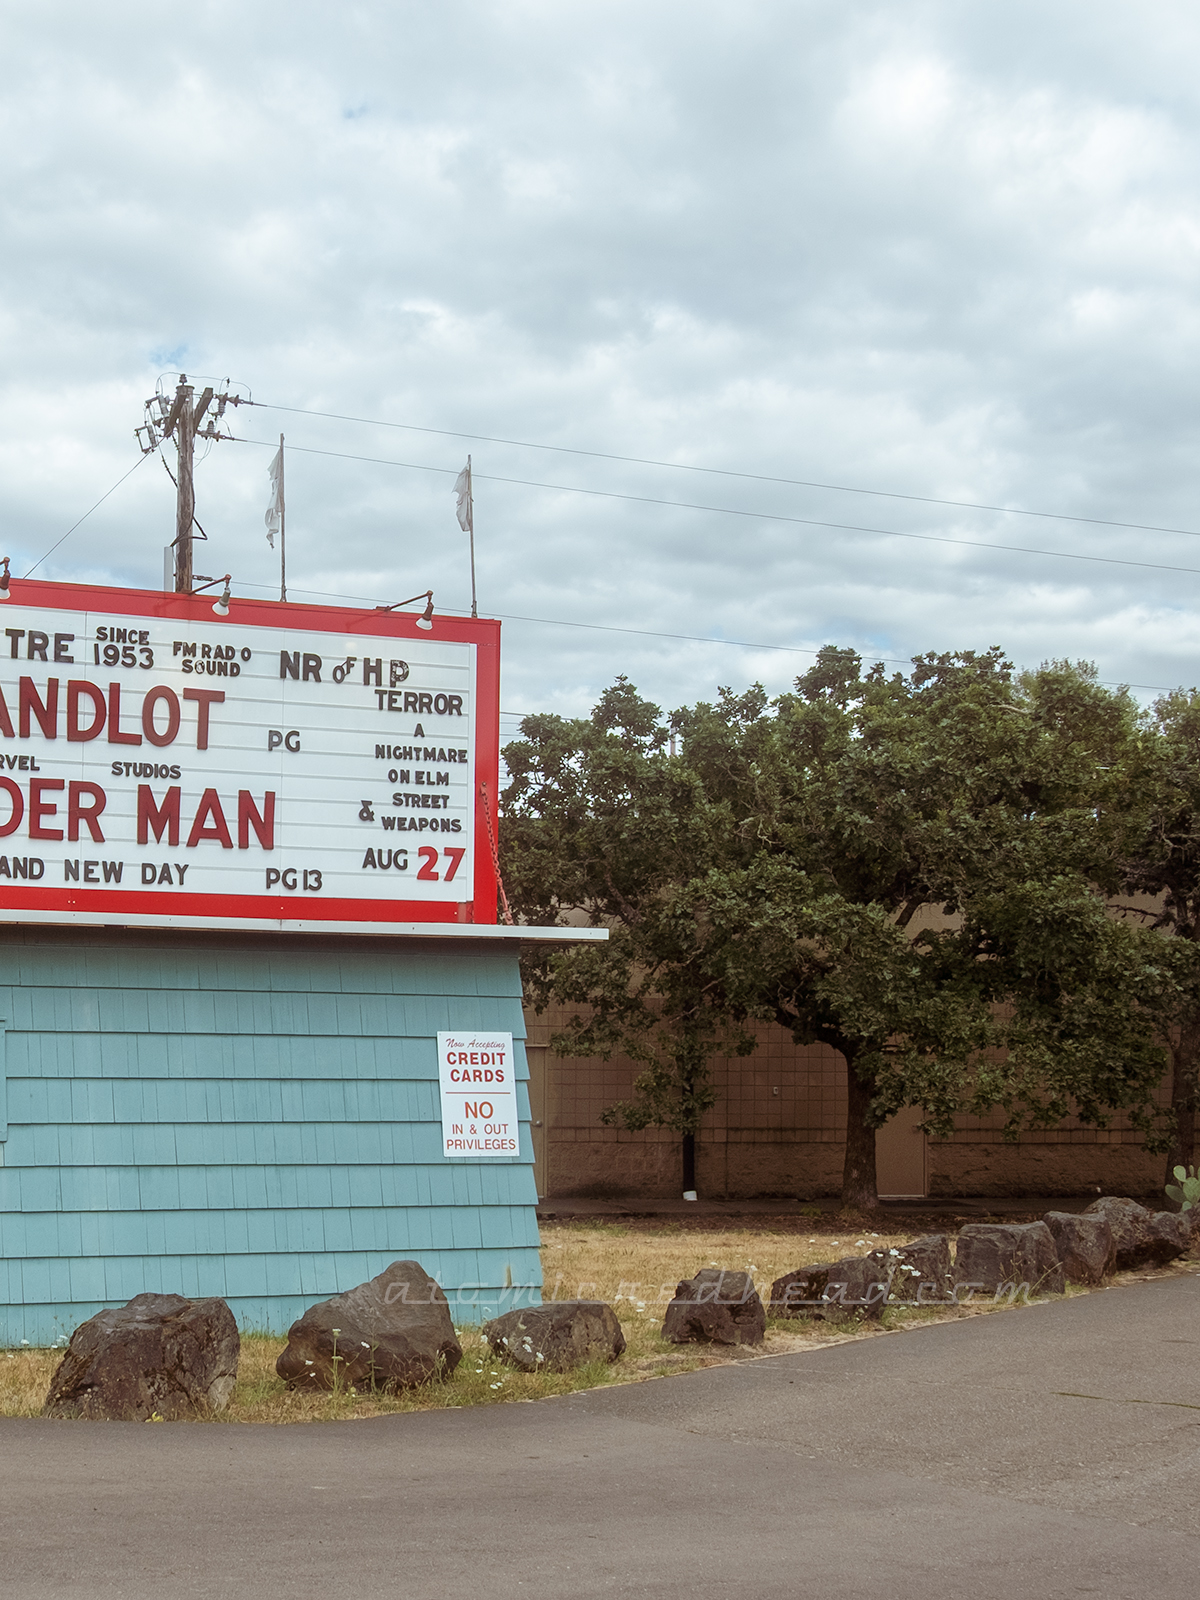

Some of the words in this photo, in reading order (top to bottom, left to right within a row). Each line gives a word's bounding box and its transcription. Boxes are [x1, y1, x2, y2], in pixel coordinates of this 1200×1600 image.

[96, 626, 150, 646] SINCE
[94, 643, 154, 670] 1953
[173, 641, 197, 657] FM
[181, 659, 241, 677] SOUND
[279, 650, 322, 683] NR
[374, 690, 463, 716] TERROR
[414, 723, 426, 738] A
[268, 730, 300, 753] PG
[375, 744, 468, 764] NIGHTMARE
[111, 761, 181, 780] STUDIOS
[388, 769, 410, 785] ON
[415, 770, 449, 786] ELM
[392, 793, 449, 809] STREET
[137, 784, 275, 850] MAN
[358, 800, 374, 822] &
[381, 815, 462, 833] WEAPONS
[64, 859, 123, 884] NEW
[141, 862, 189, 886] DAY
[362, 848, 408, 871] AUG
[416, 845, 466, 882] 27
[446, 1038, 464, 1048] Now
[467, 1039, 506, 1050] Accepting
[447, 1052, 506, 1065] CREDIT
[450, 1069, 505, 1082] CARDS
[465, 1101, 494, 1119] NO
[452, 1124, 463, 1135] IN
[469, 1124, 478, 1135] &
[484, 1124, 508, 1135] OUT
[447, 1139, 516, 1150] PRIVILEGES
